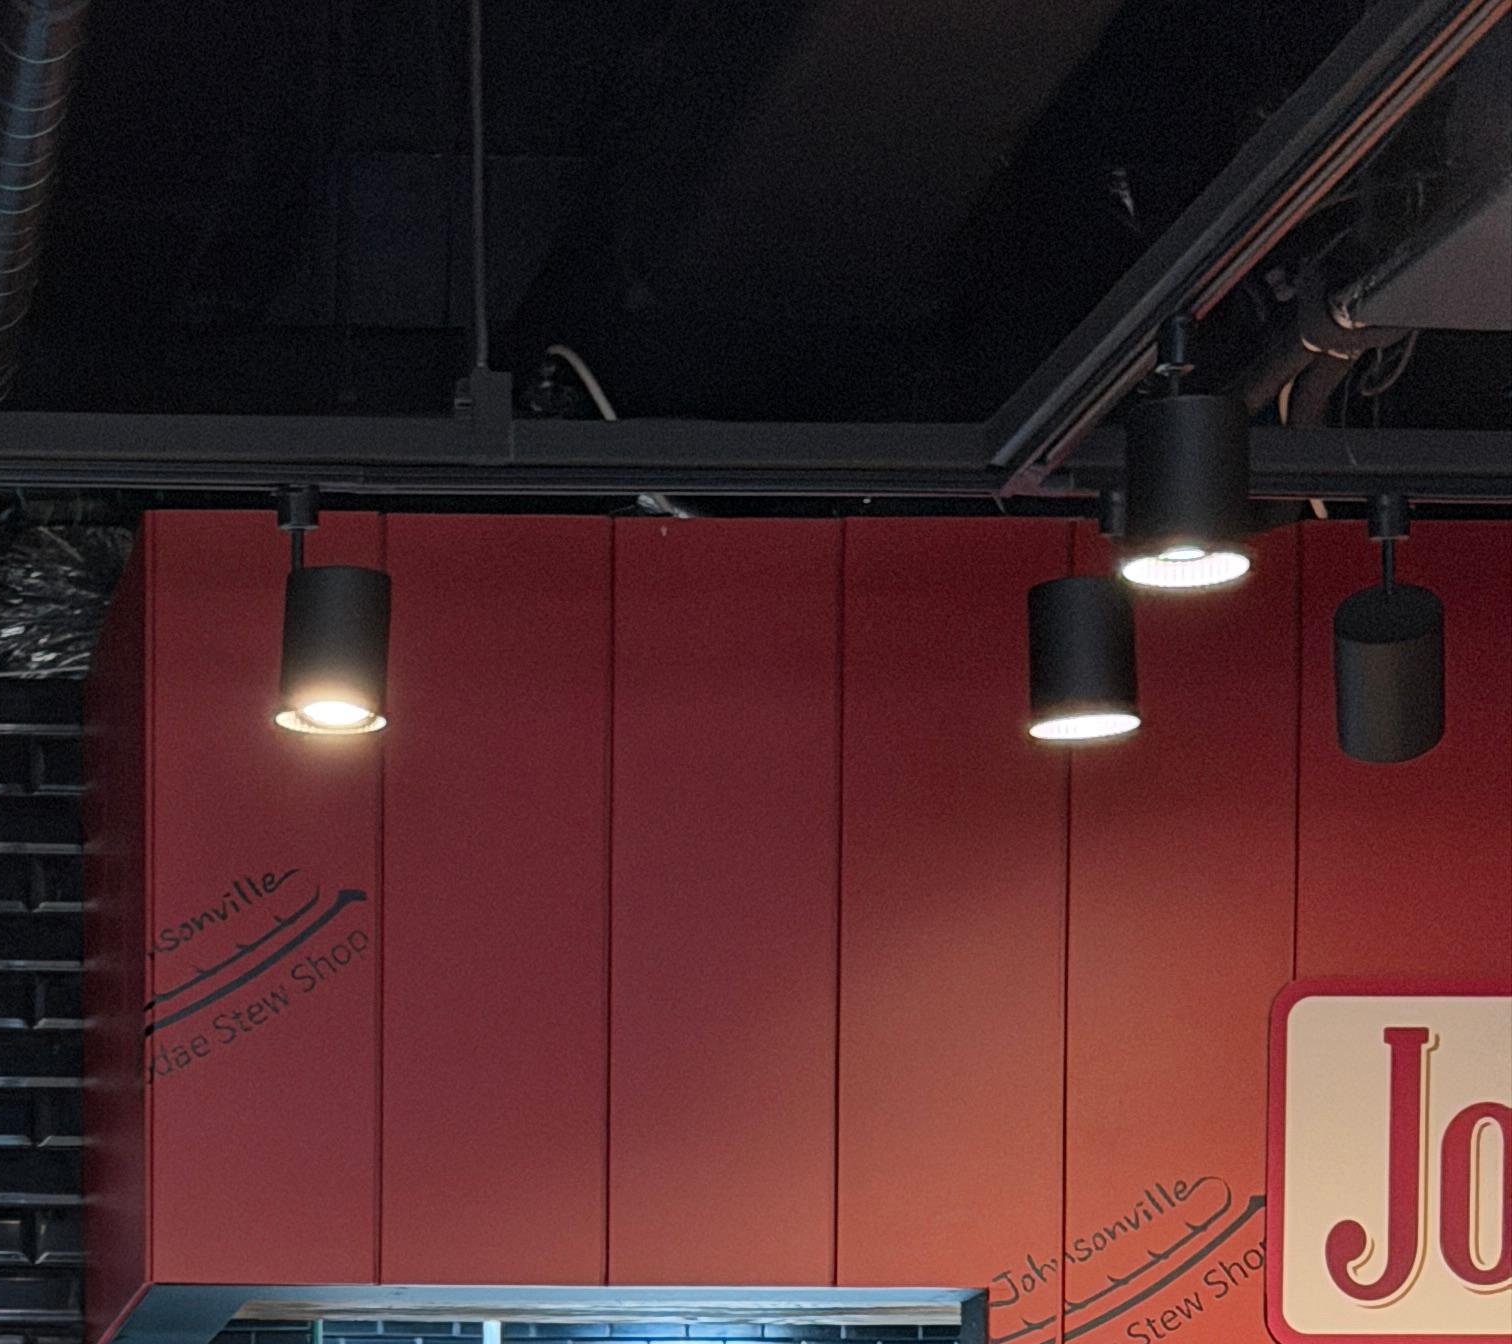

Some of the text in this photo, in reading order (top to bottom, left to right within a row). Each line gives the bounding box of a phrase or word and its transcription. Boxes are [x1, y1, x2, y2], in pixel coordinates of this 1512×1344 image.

[213, 985, 291, 1045] Stew
[291, 928, 370, 992] Shop
[990, 1177, 1206, 1307] Johnsonville
